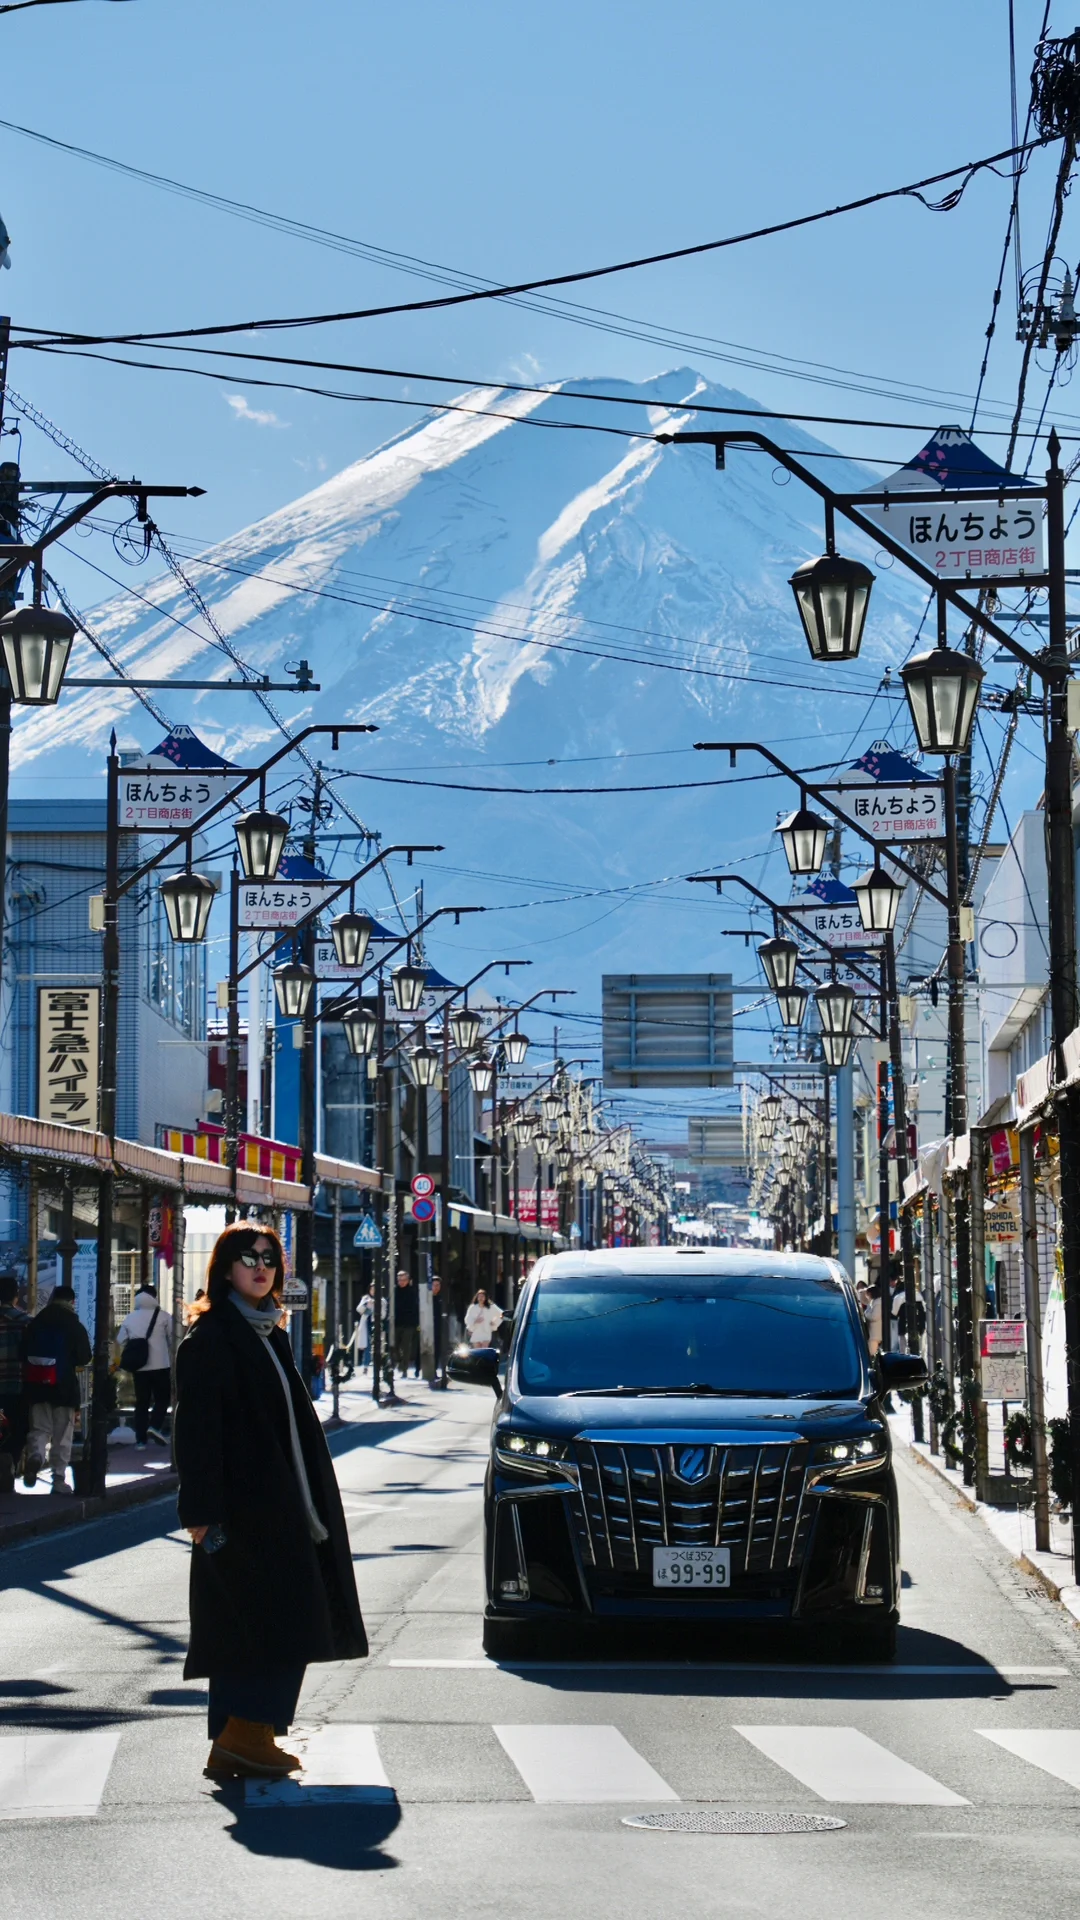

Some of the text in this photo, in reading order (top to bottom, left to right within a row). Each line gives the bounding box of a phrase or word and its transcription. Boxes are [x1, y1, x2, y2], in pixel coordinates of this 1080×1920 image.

[909, 509, 1036, 544] ほんちょう
[935, 546, 1036, 568] 2丁目商店街
[126, 782, 211, 804] ほんちょう
[125, 806, 193, 820] 2丁目商店街
[854, 795, 936, 817] ほんちょう
[872, 818, 937, 832] 2丁目商店街
[245, 891, 312, 908] ほんちょう
[416, 1180, 430, 1191] 40
[984, 1211, 1013, 1220] OSHIDA
[990, 1221, 1018, 1232] HOSTEL
[657, 1563, 727, 1585] ほ 99-99
